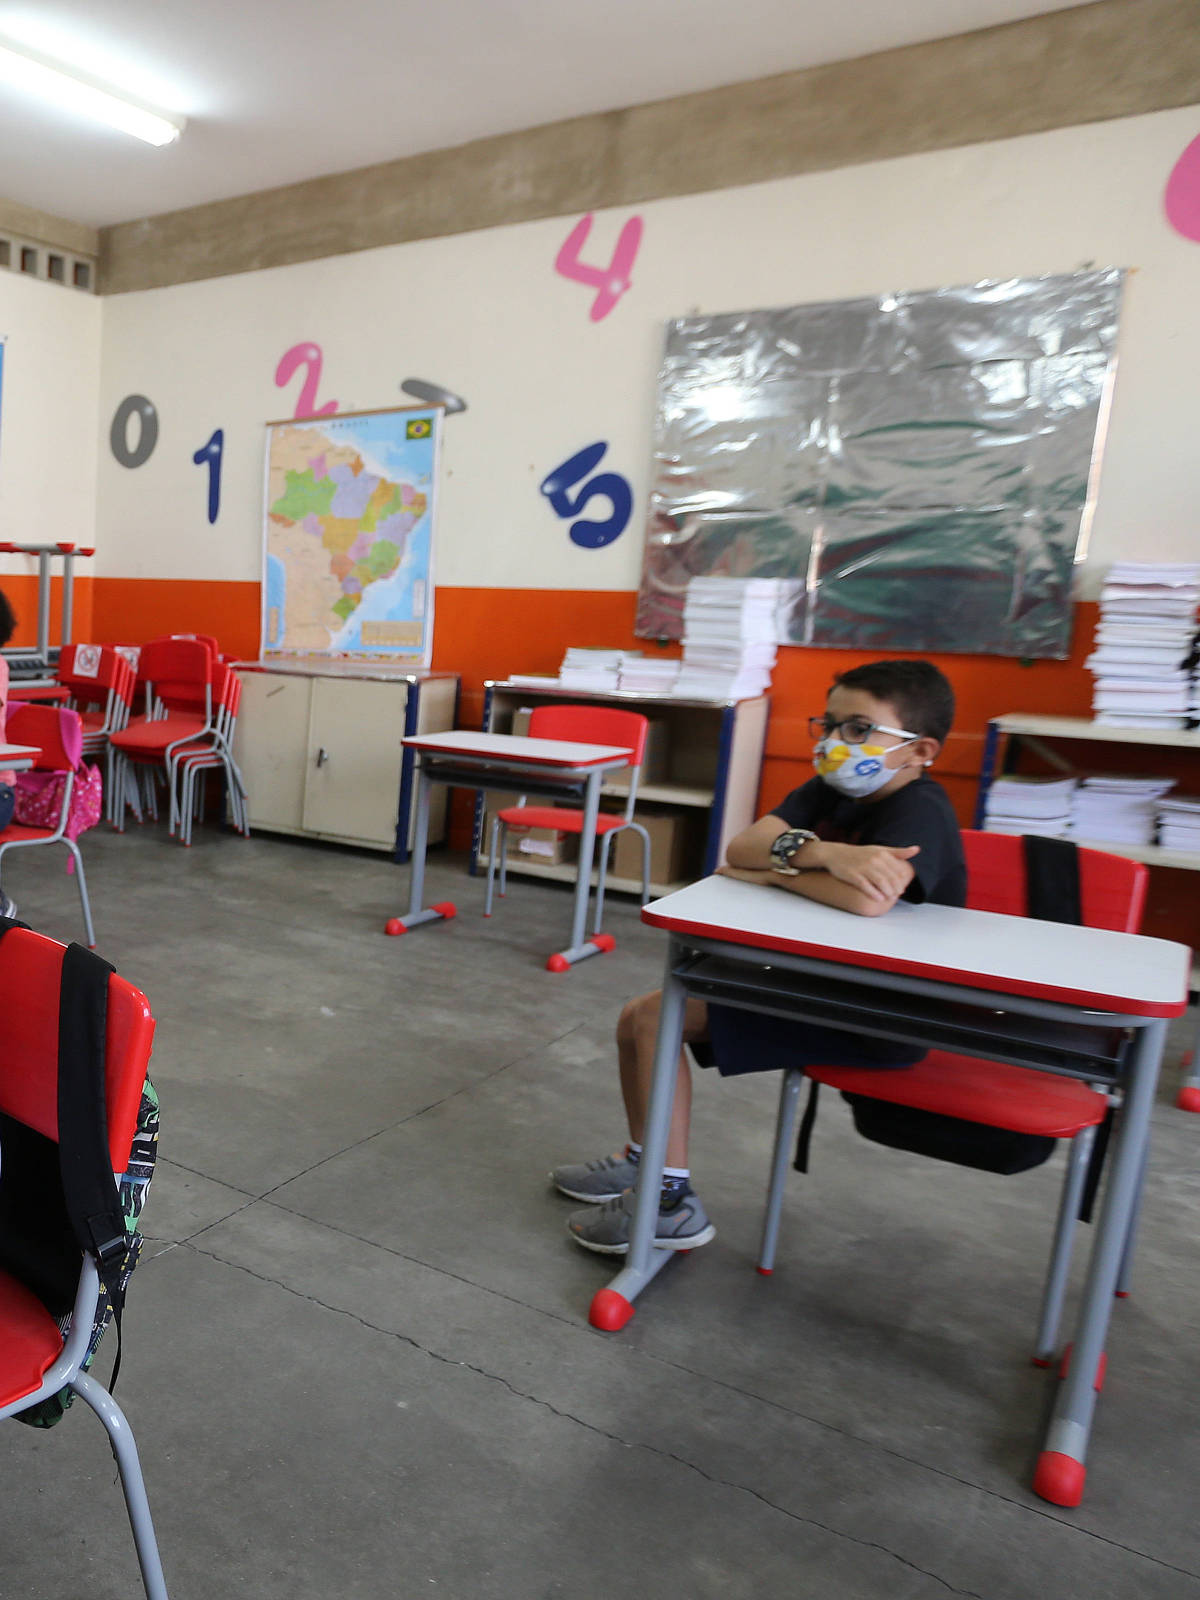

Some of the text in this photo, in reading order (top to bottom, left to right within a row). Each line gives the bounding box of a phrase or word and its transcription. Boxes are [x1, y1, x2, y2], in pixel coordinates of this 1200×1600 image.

[555, 212, 644, 322] 4
[274, 341, 339, 420] 2
[110, 394, 159, 469] 0
[192, 428, 224, 524] 1
[541, 440, 634, 549] 5
